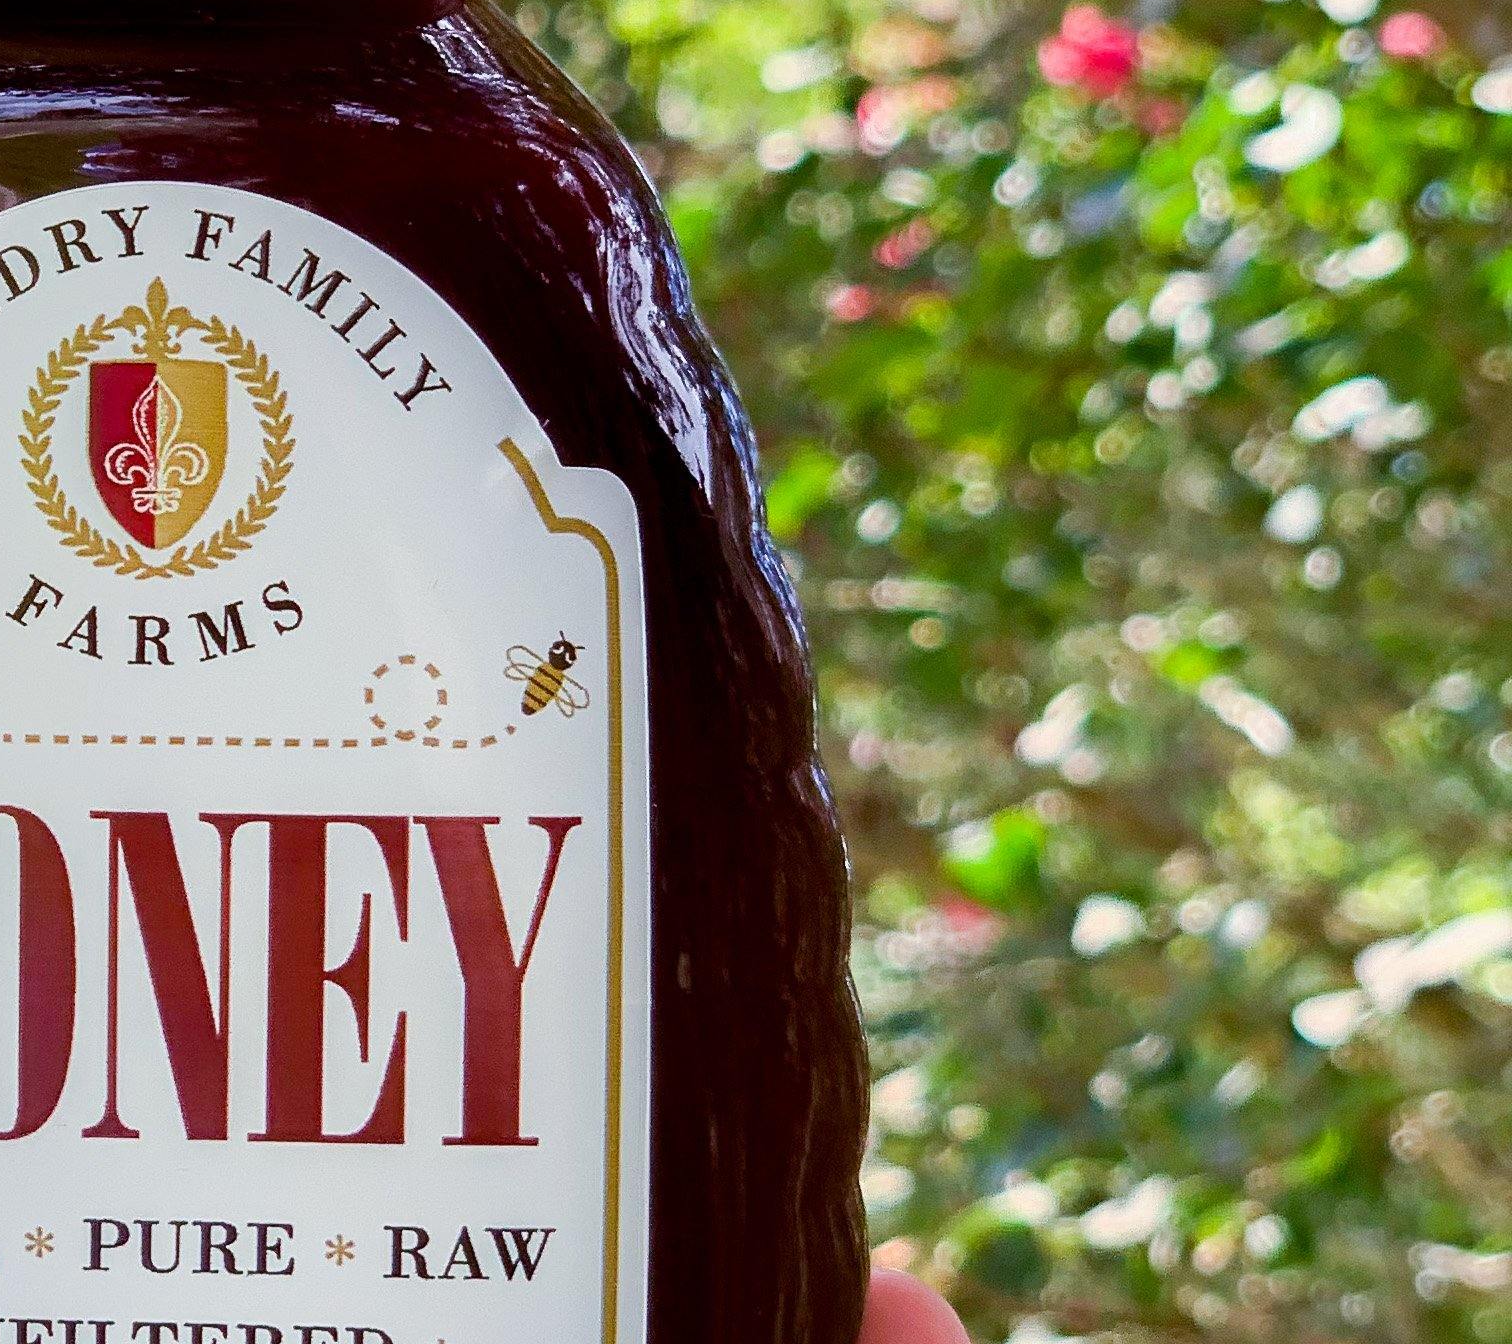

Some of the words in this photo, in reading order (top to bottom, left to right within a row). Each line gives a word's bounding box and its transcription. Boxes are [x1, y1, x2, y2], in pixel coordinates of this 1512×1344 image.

[184, 208, 452, 413] FAMILY
[5, 573, 303, 666] FARMS
[82, 1218, 295, 1276] PURE
[382, 1225, 557, 1282] RAW
